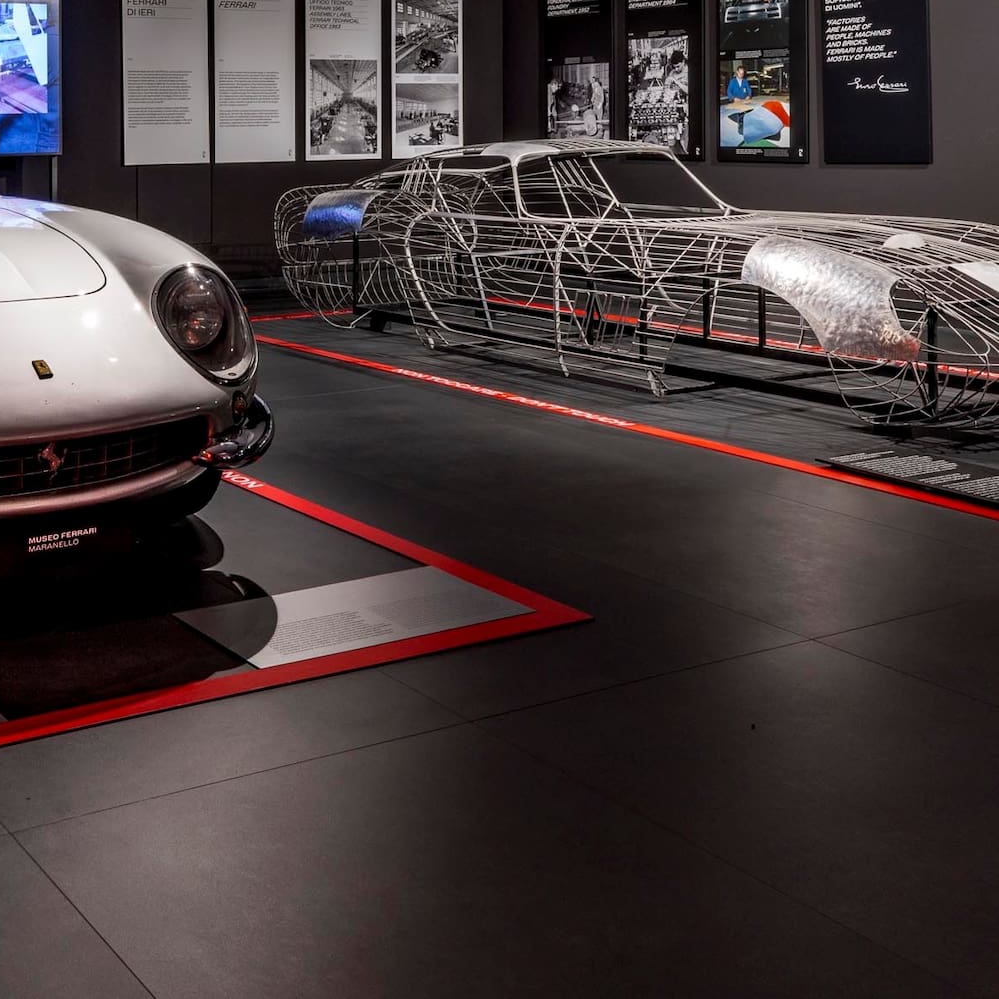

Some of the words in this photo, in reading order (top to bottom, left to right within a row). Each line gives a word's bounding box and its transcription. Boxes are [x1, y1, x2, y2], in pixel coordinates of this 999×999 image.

[218, 1, 257, 9] FERRARI
[628, 0, 662, 9] DEPARTMENT
[127, 9, 137, 17] DI
[138, 9, 156, 17] IERI
[841, 24, 861, 32] MADE
[826, 32, 854, 40] PEOPLE,
[854, 29, 892, 38] MACHINES
[842, 39, 868, 47] BRICKS.
[826, 47, 855, 55] FERRARI
[826, 54, 854, 62] MOSTLY
[222, 472, 264, 488] NON
[29, 534, 59, 544] MUSEO
[61, 527, 97, 539] FERRARI
[29, 539, 79, 552] MARANELLO
